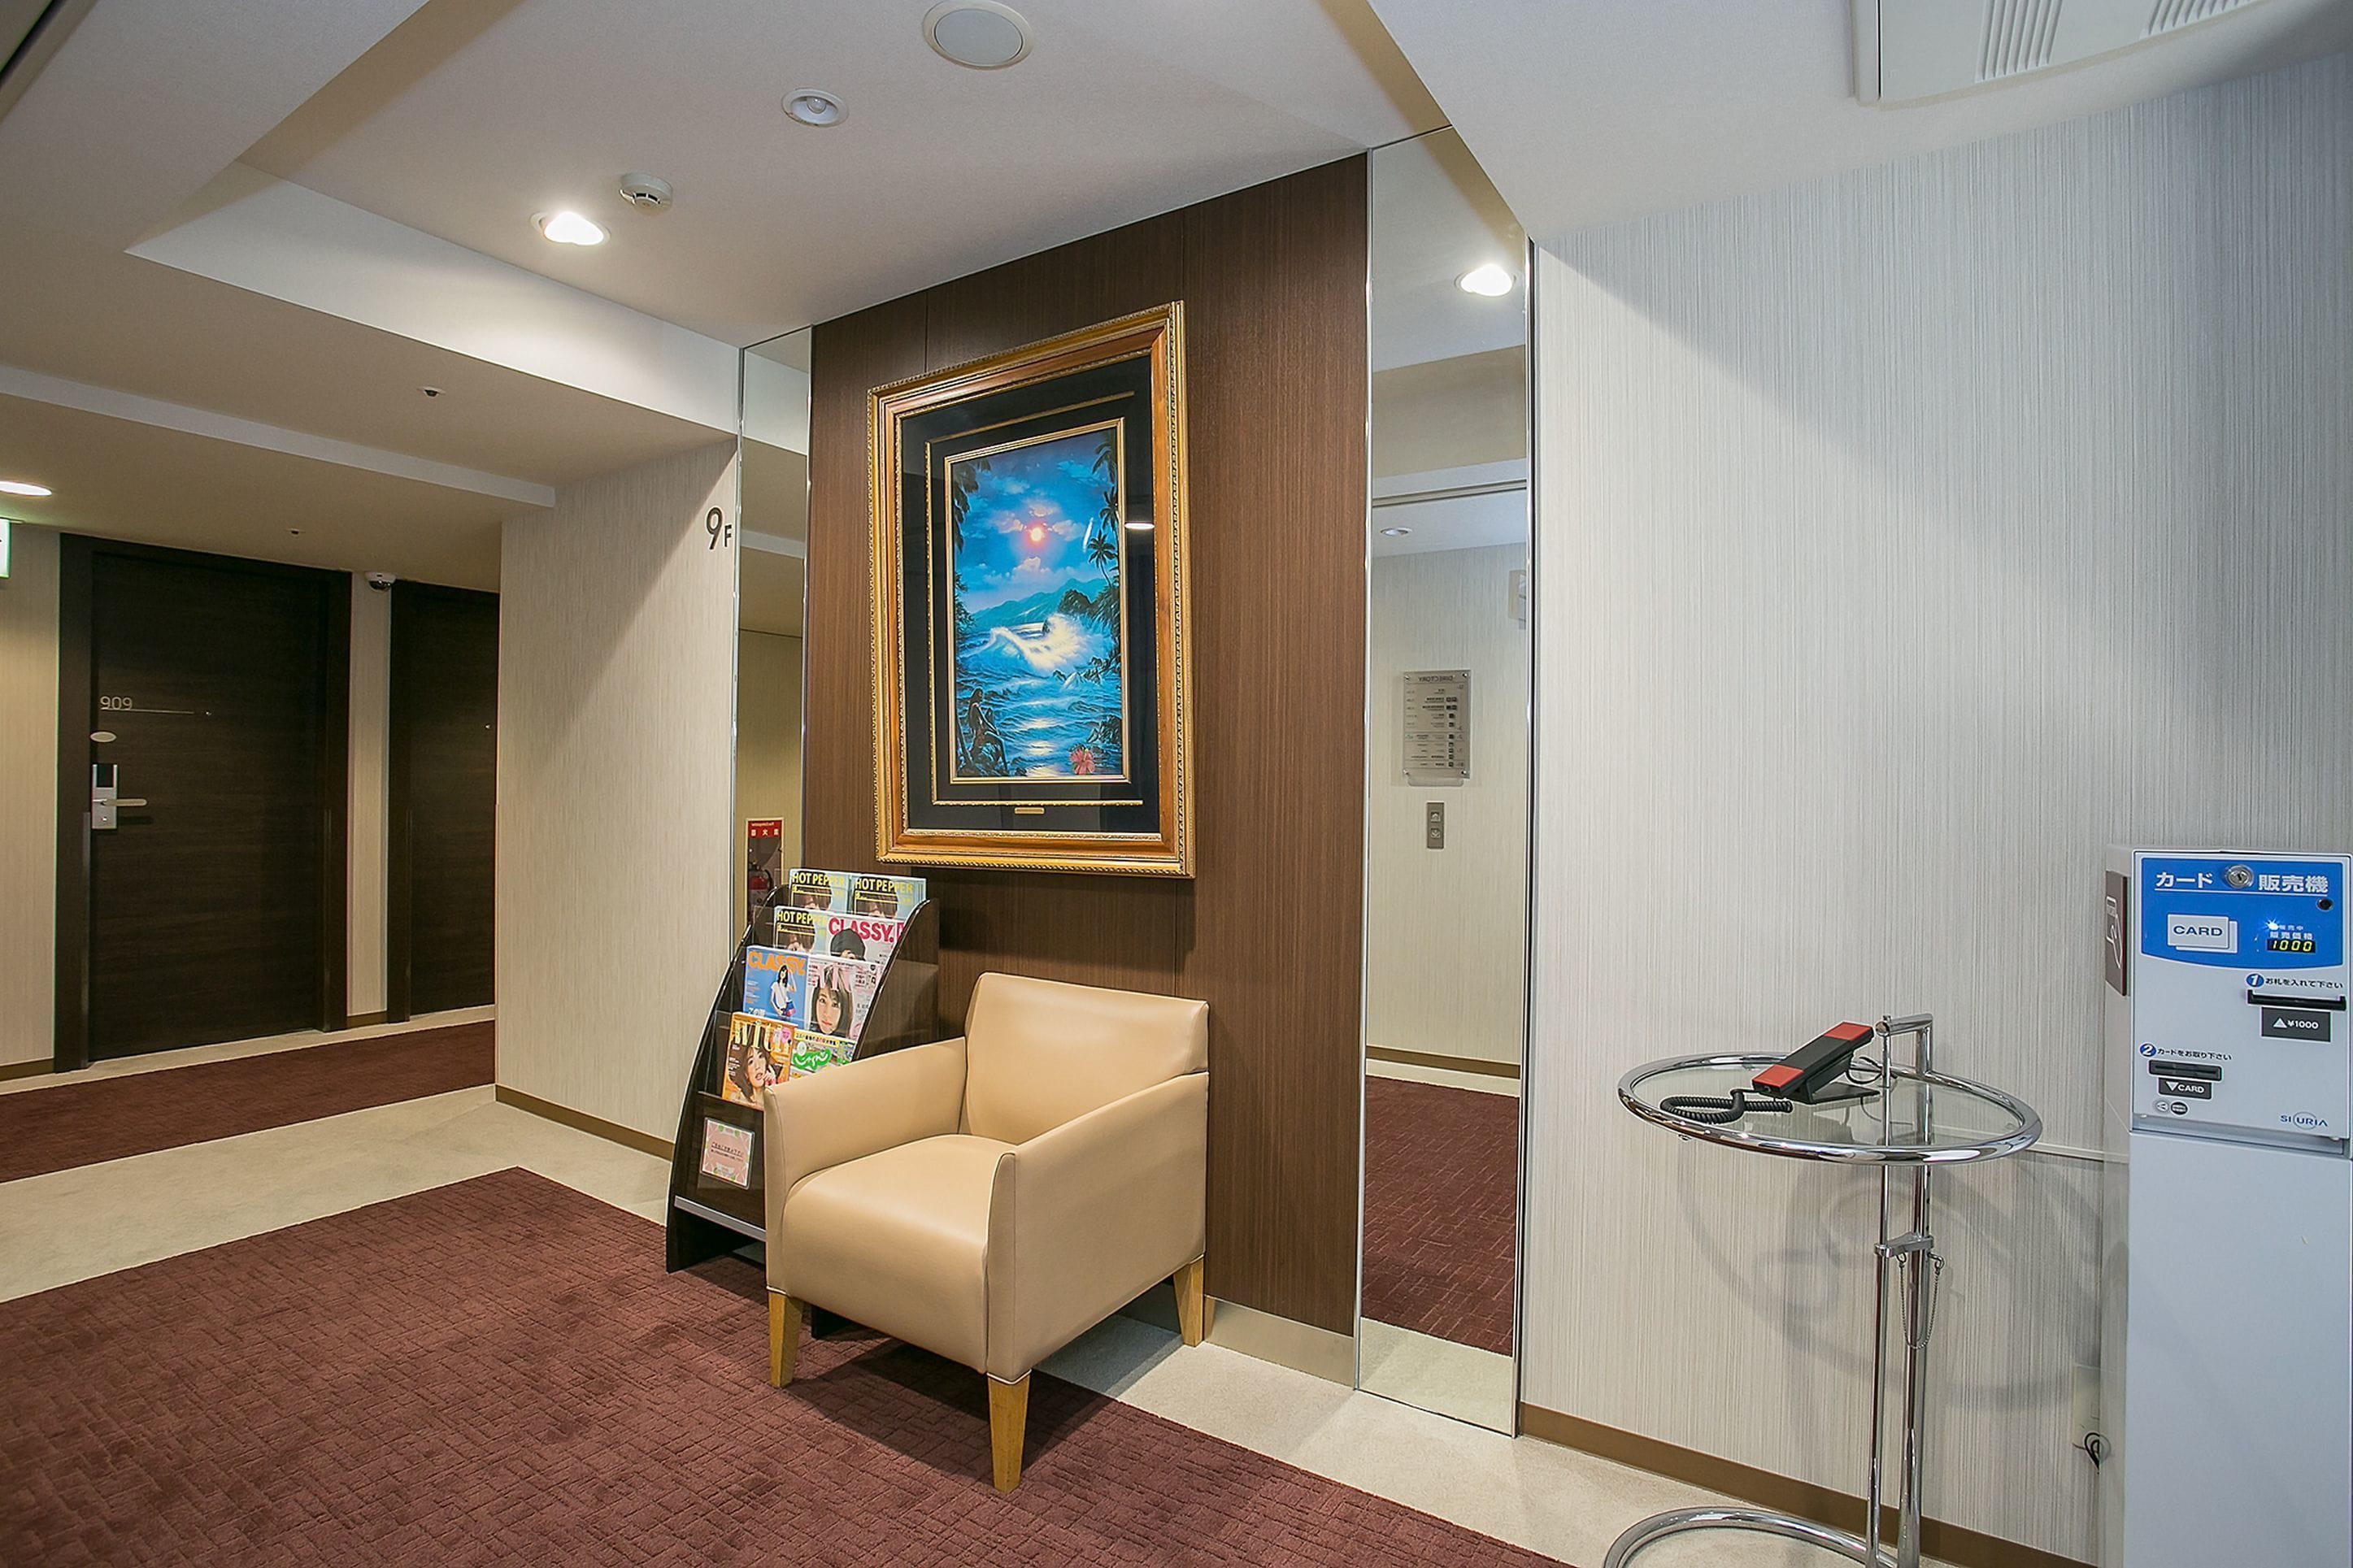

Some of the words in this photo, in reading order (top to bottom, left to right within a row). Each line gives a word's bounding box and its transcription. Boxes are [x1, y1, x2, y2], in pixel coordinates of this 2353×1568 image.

[707, 506, 733, 550] 9F
[100, 695, 133, 710] 909
[792, 871, 811, 884] HOT
[812, 873, 845, 887] PEPPER
[2155, 871, 2213, 888] カード
[2258, 874, 2329, 893] 販売機
[855, 878, 876, 891] HOT
[876, 880, 914, 894] PEPPER
[776, 910, 796, 923] HOT
[2173, 925, 2223, 937] CARD
[2273, 940, 2312, 952] 1000
[2265, 977, 2343, 988] お札を入れて下さい
[2158, 1049, 2232, 1061] カードをお取り下さい
[2177, 1084, 2205, 1093] CARD
